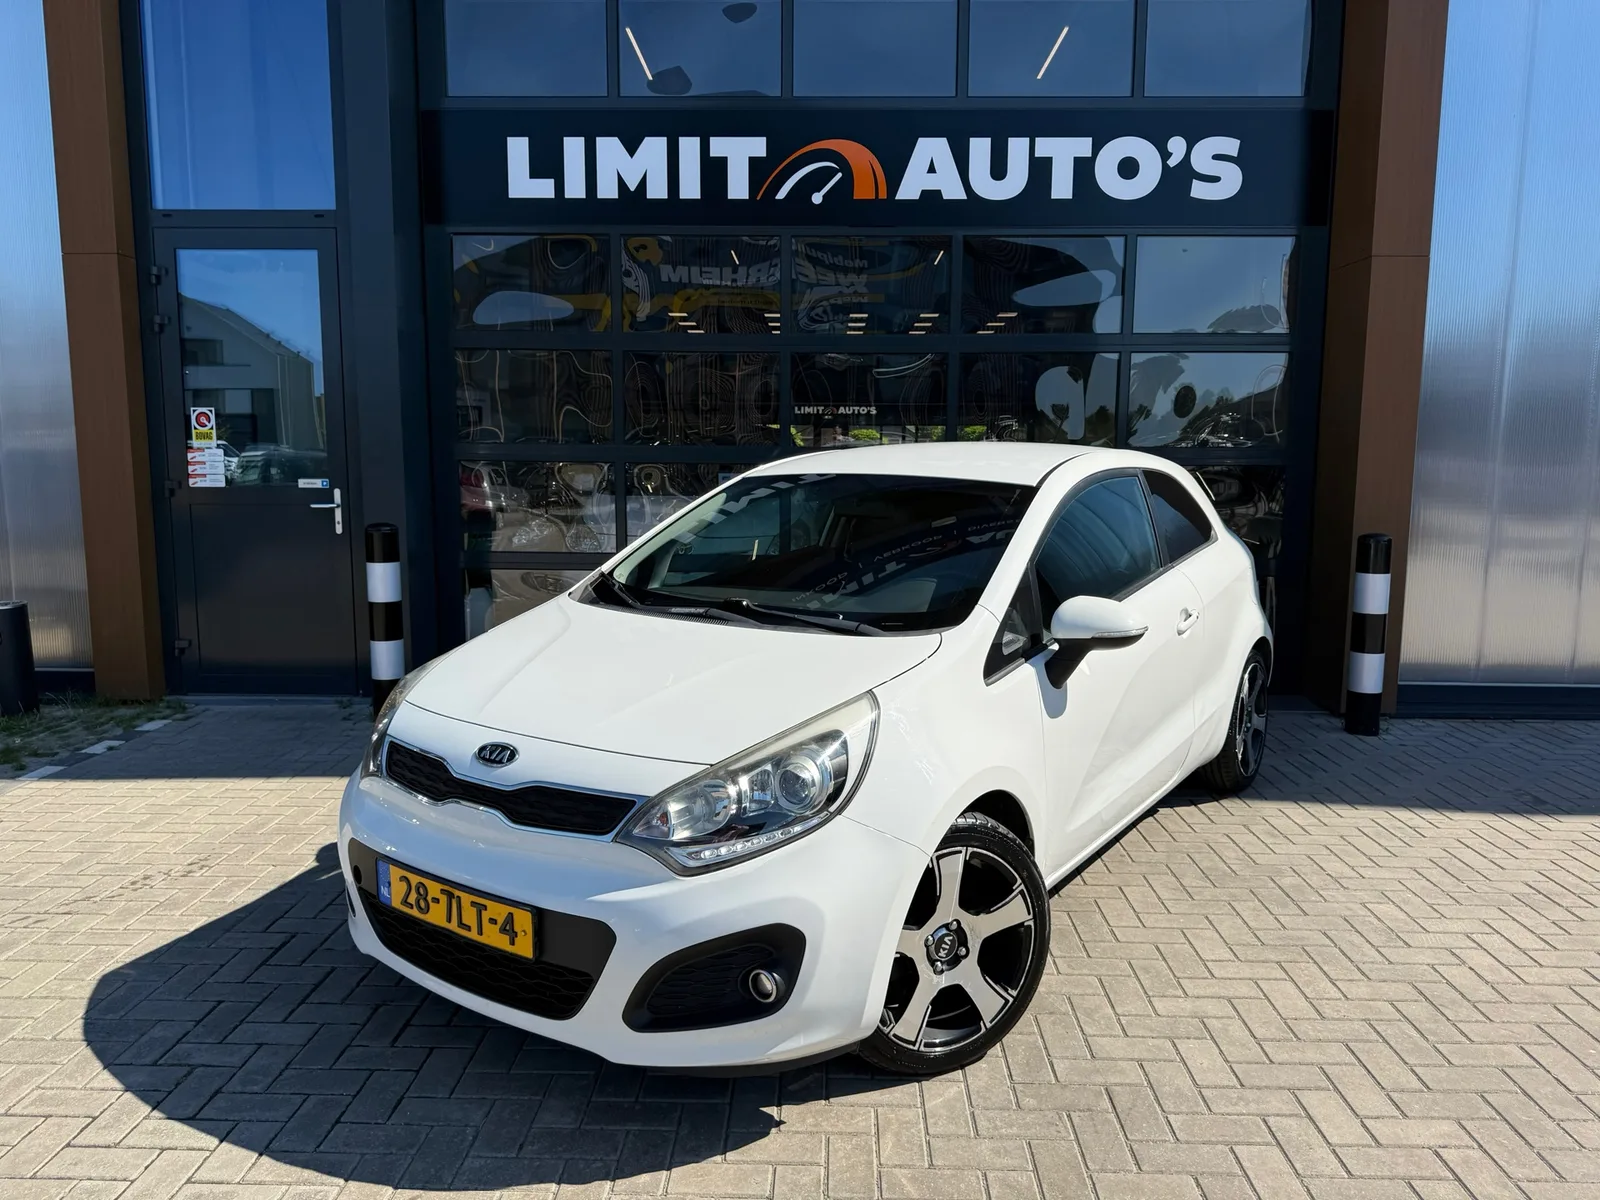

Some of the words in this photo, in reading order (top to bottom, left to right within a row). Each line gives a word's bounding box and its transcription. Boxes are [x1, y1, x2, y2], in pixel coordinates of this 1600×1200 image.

[507, 136, 767, 199] LIMIT
[895, 136, 1243, 201] AUTO'S
[794, 406, 825, 415] LIMIT
[838, 406, 877, 415] AUTO'S
[195, 430, 214, 441] BOVAG
[480, 745, 511, 763] KIA
[380, 886, 391, 898] NL
[399, 875, 518, 946] 28-TLT-4
[937, 936, 954, 958] KIA
